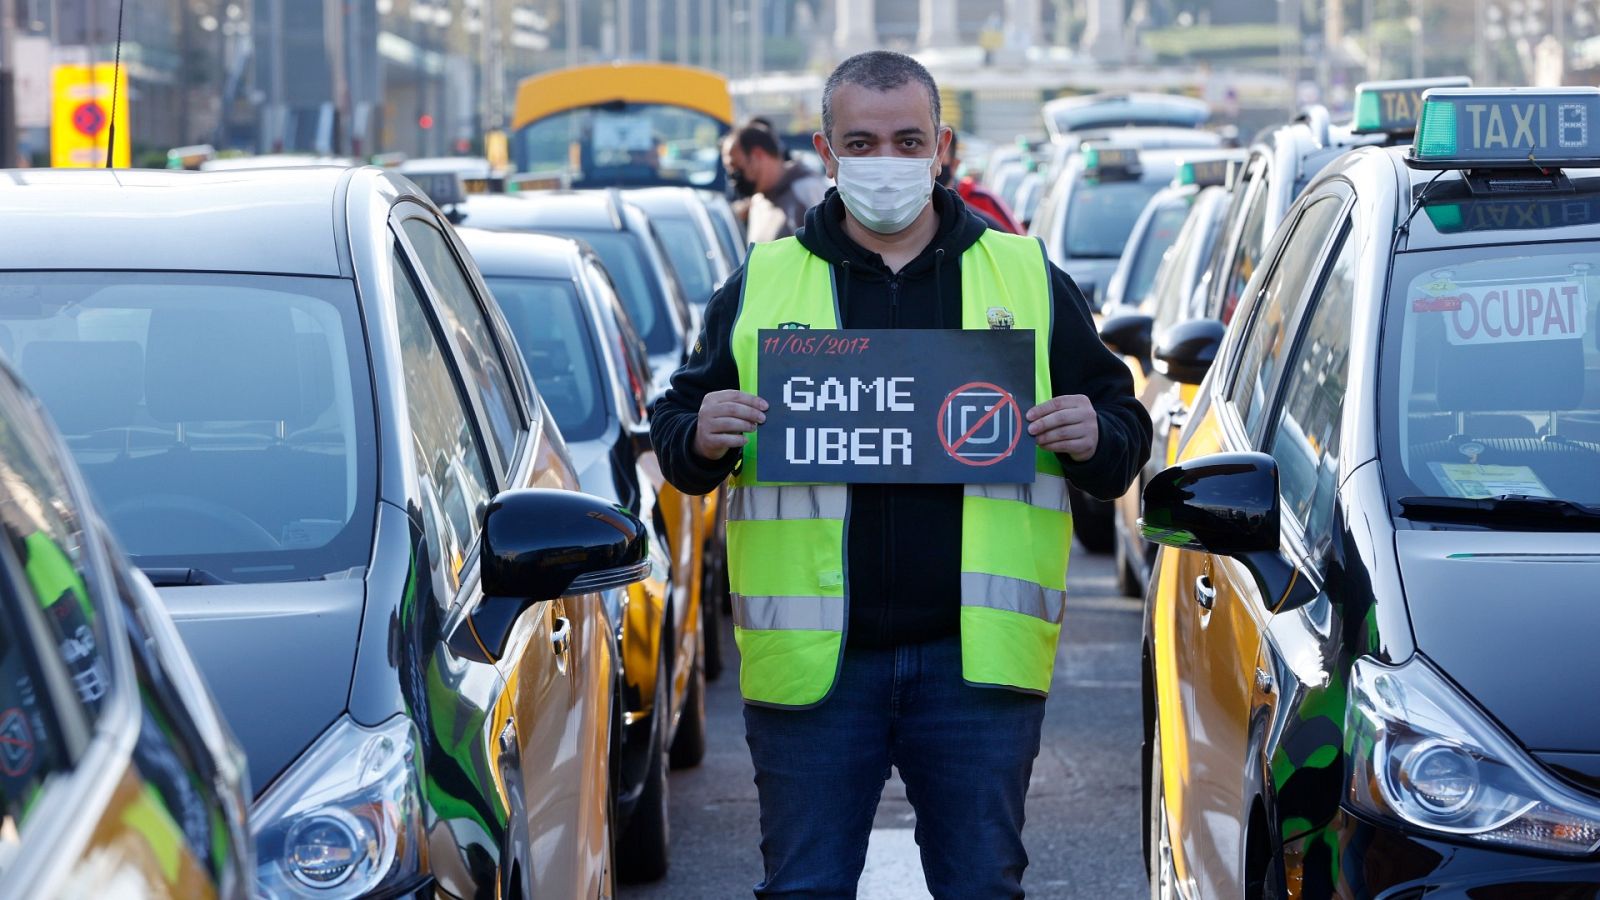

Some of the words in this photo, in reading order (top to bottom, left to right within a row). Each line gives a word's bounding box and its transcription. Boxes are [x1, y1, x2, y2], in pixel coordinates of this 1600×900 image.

[1465, 103, 1548, 149] TAXI
[1452, 286, 1578, 340] OCUPAT
[764, 334, 870, 356] 11/05/2017
[783, 377, 914, 411] GAME
[785, 427, 912, 465] UBER
